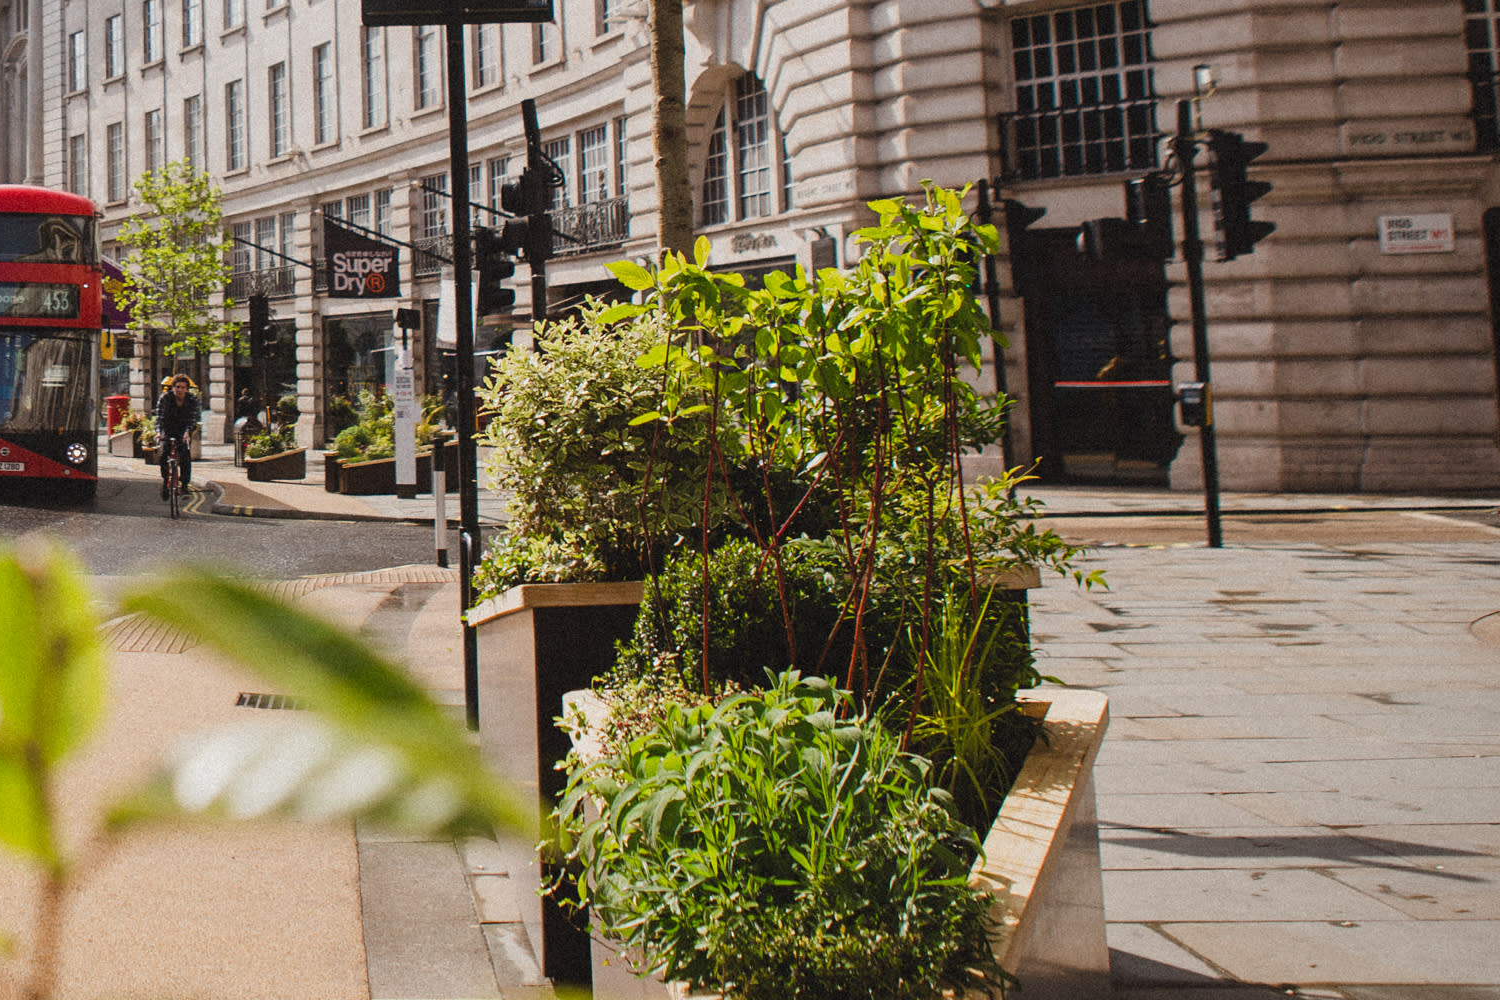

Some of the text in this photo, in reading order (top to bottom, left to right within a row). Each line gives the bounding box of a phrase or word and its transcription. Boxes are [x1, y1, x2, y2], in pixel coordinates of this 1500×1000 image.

[1395, 130, 1445, 143] STREET
[1387, 230, 1429, 241] STREET
[333, 252, 393, 278] Super
[43, 289, 70, 311] 453
